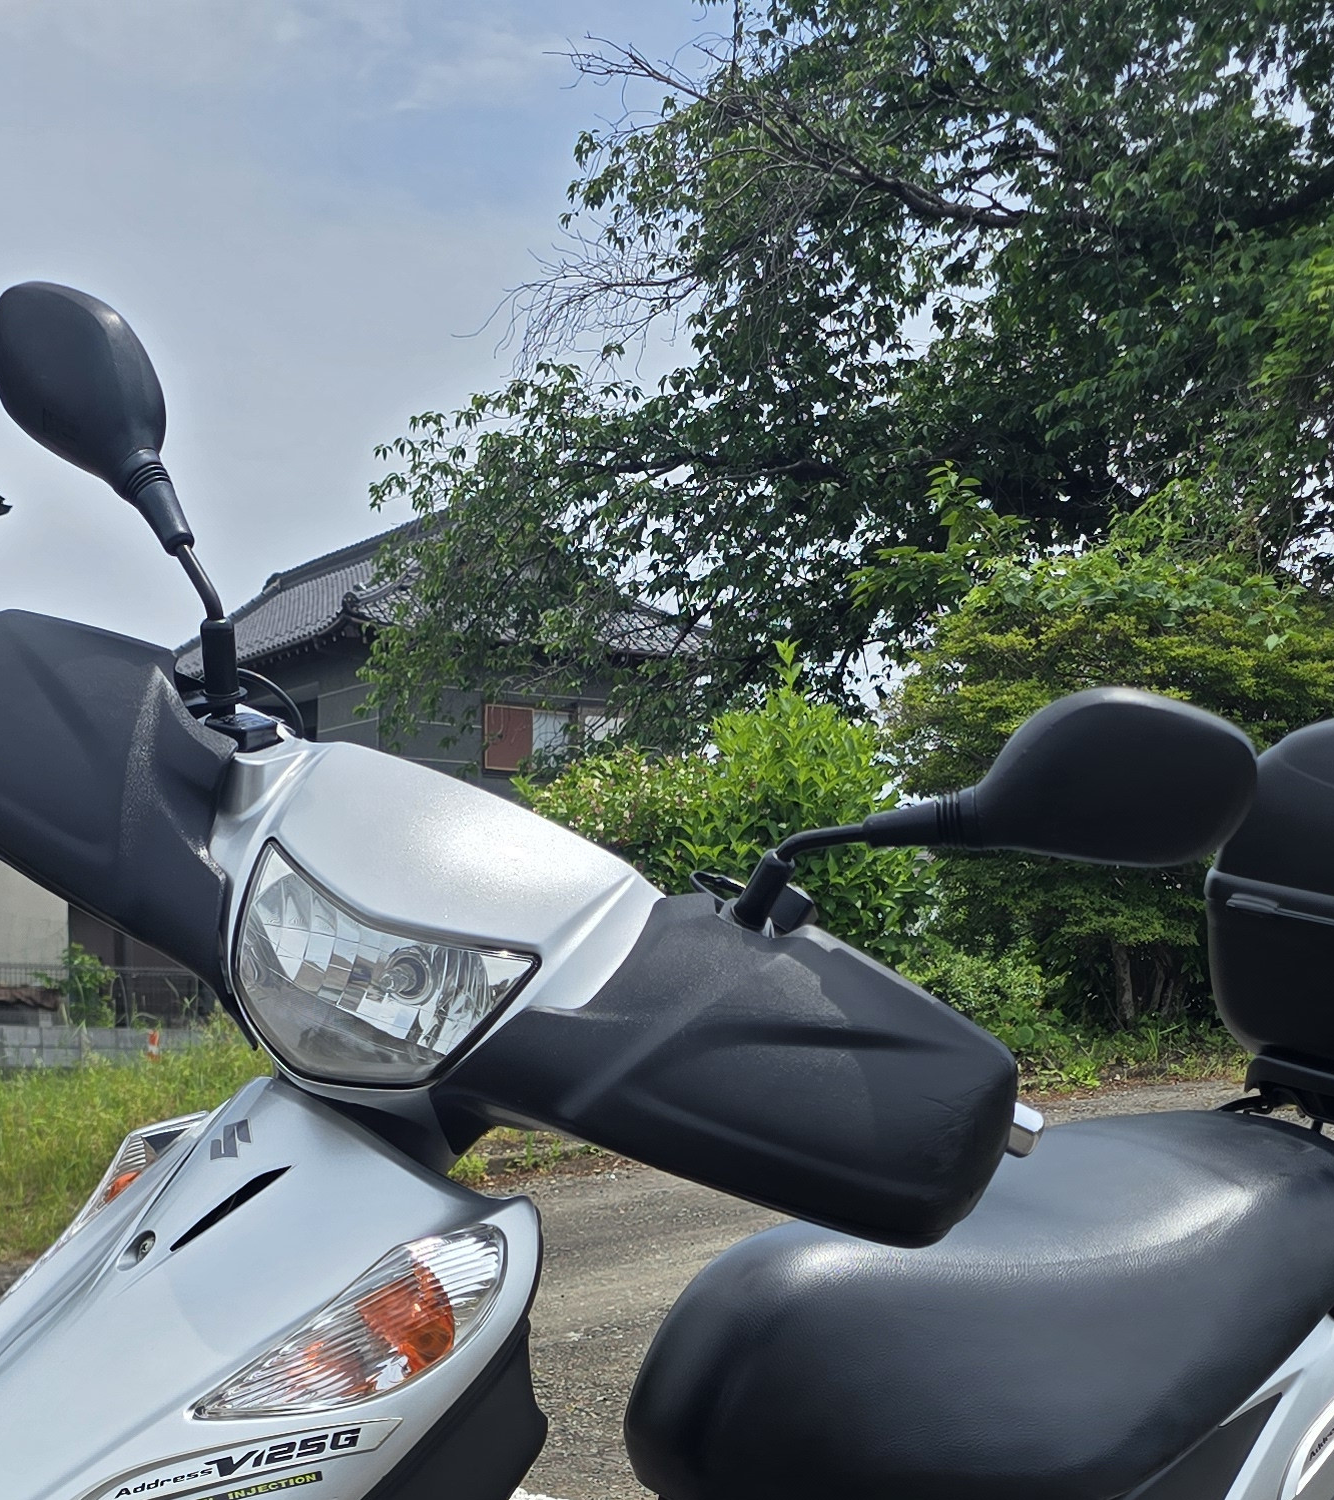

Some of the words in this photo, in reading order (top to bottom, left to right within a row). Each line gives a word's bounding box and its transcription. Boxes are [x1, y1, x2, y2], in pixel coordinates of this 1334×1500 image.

[114, 1467, 214, 1499] Address
[204, 1427, 362, 1478] V125G
[227, 1473, 317, 1500] INJECTION
